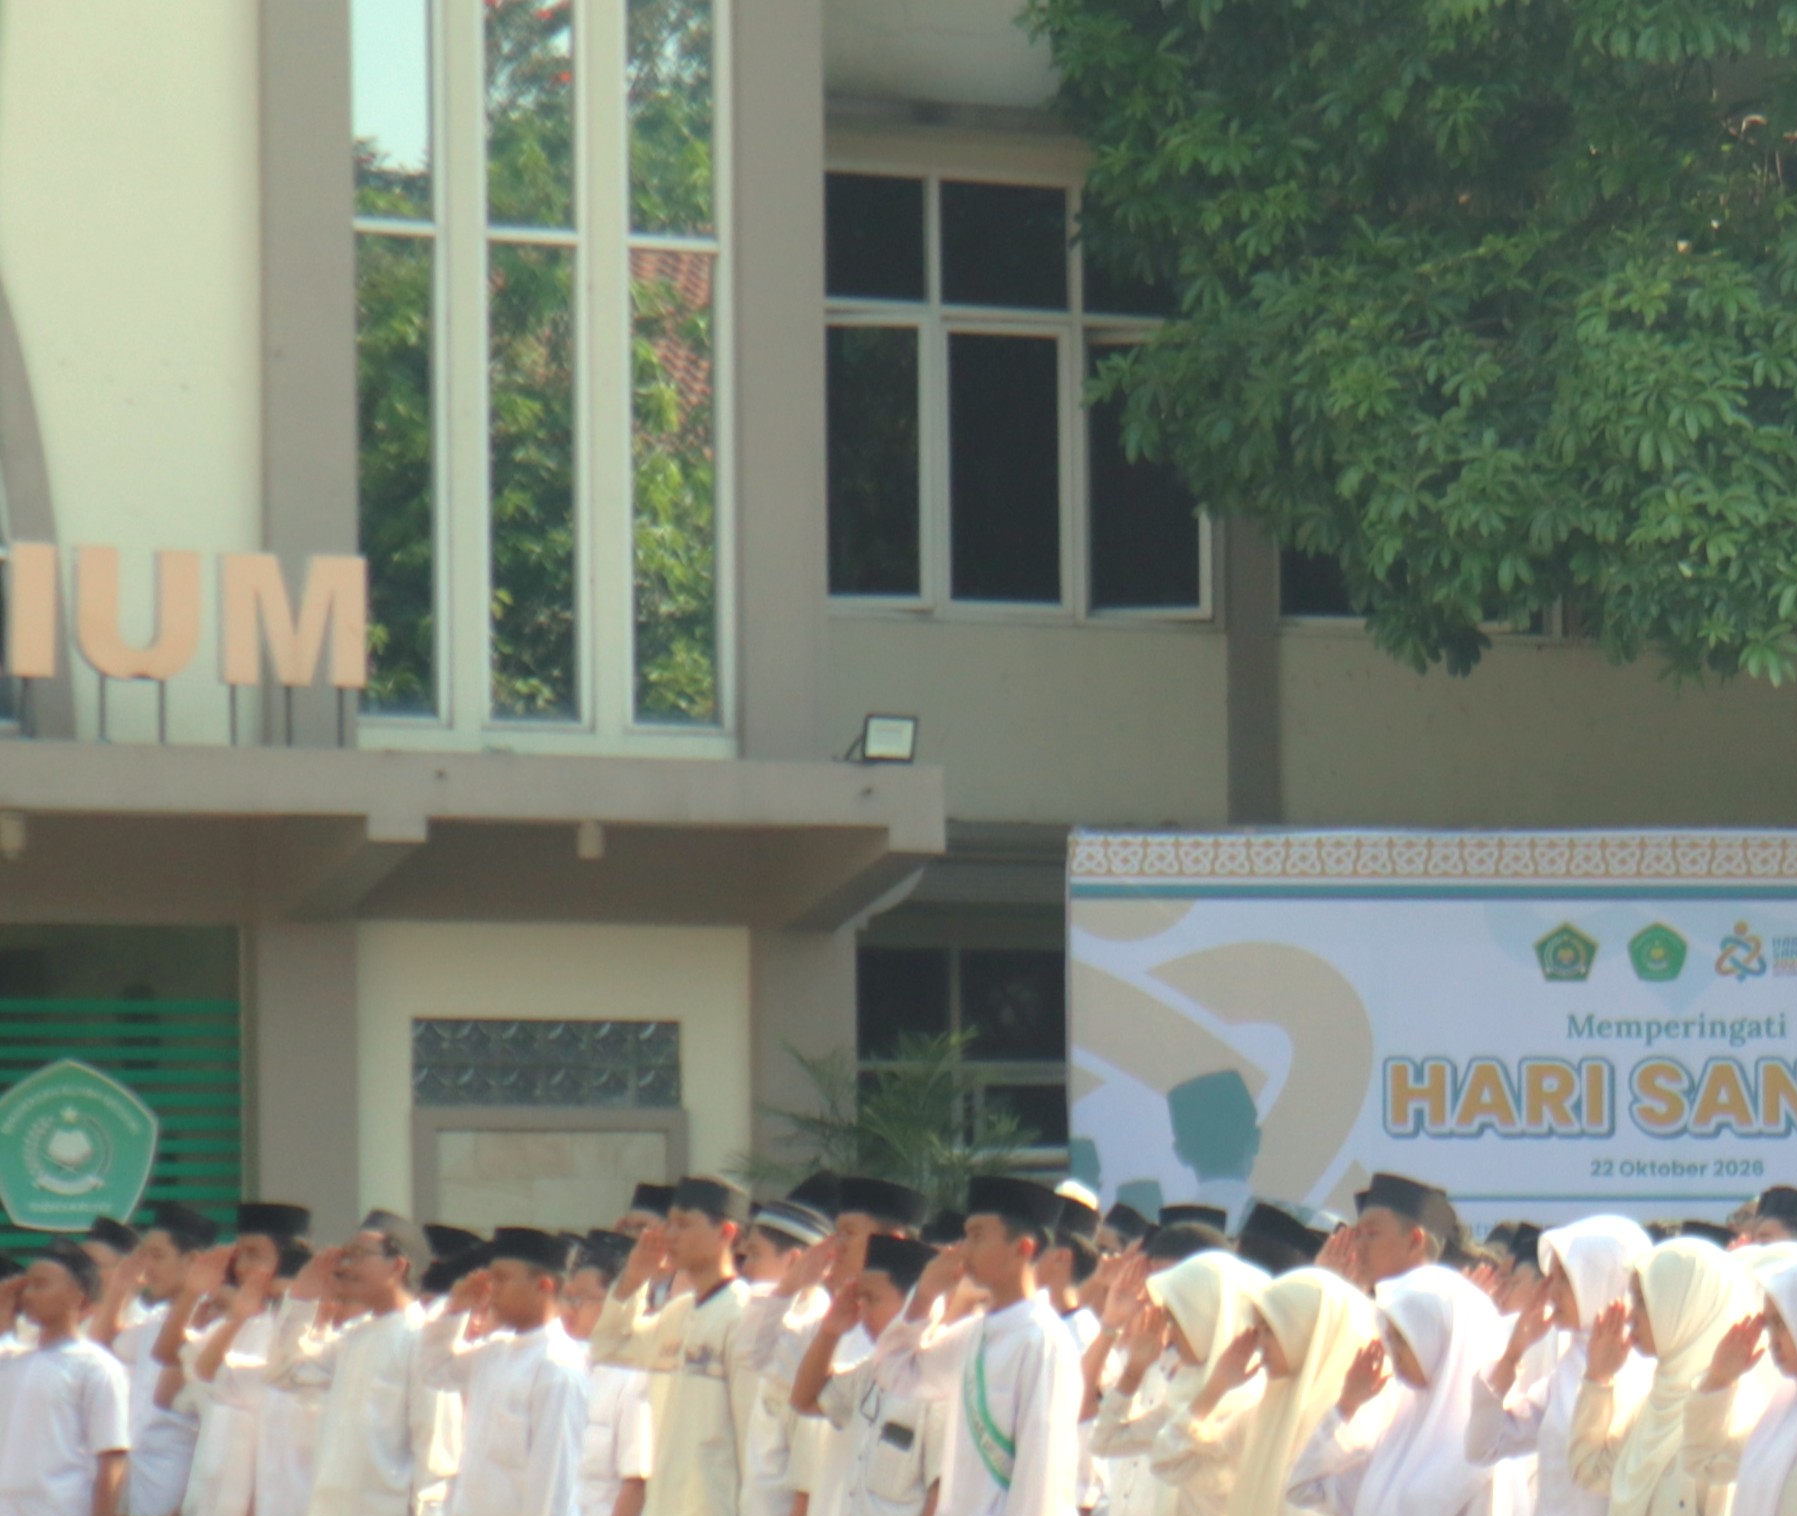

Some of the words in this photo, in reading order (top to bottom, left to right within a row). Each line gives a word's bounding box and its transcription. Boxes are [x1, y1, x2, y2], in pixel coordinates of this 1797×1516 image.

[13, 544, 368, 687] IUM
[1567, 1012, 1787, 1046] Memperingati
[1384, 1057, 1615, 1138] HARI
[1590, 1159, 1614, 1177] 22
[1619, 1159, 1707, 1177] Oktober
